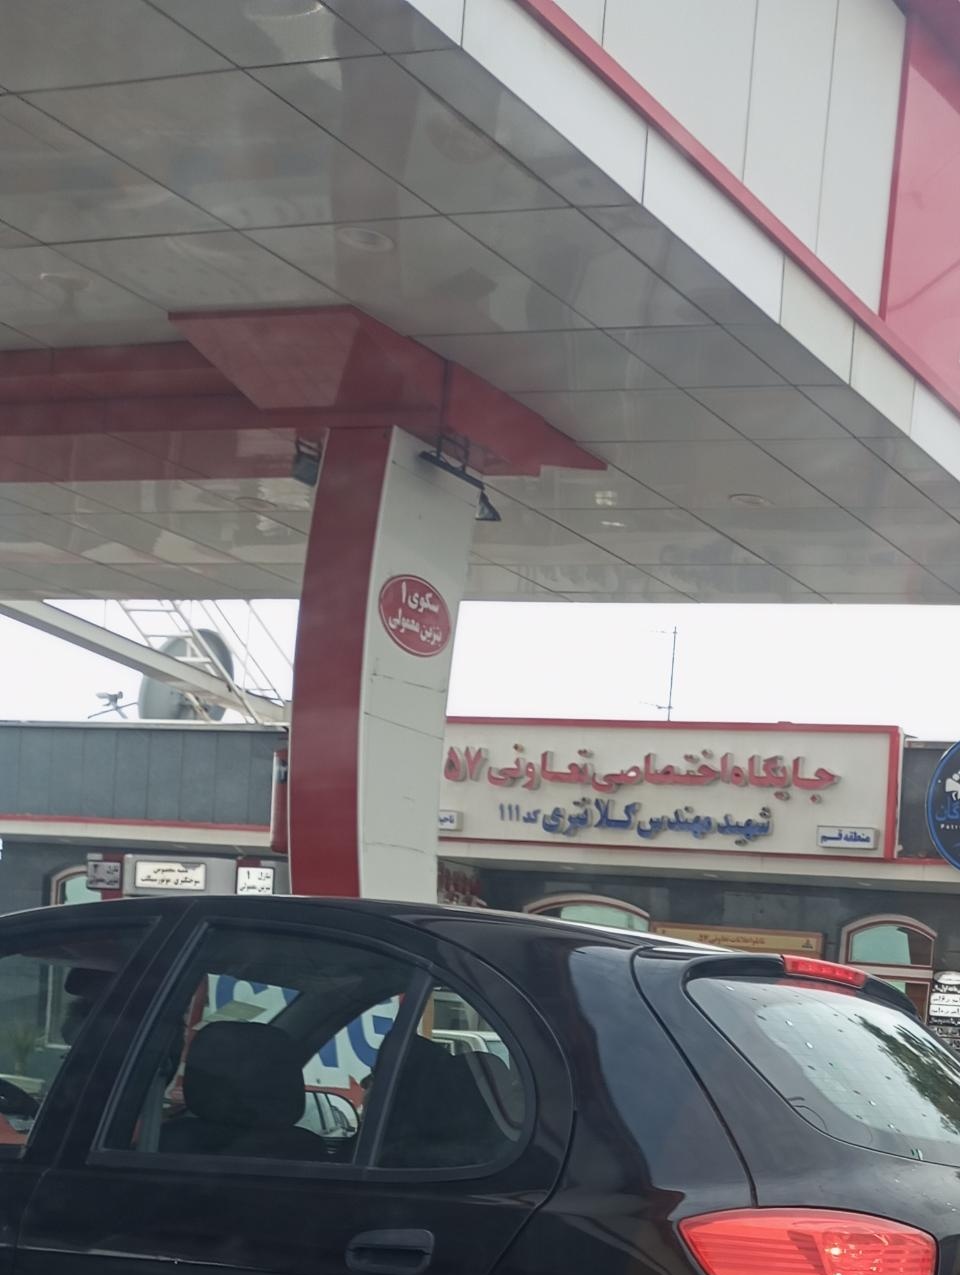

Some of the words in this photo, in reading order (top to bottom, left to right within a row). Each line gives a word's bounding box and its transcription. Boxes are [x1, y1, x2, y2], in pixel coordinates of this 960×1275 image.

[401, 581, 407, 604] ۱
[407, 592, 440, 613] سکوی
[388, 607, 420, 633] معمولی
[420, 625, 442, 646] بنزین
[443, 746, 487, 783] ۵۷
[487, 743, 594, 791] تعاونی
[592, 749, 734, 794] اختصاصی
[731, 754, 842, 804] جایگاه
[439, 815, 455, 826] ناحی
[500, 803, 520, 822] ۱۱۱
[521, 808, 541, 824] کد
[542, 797, 641, 837] کلانتری
[637, 806, 716, 840] مهندس
[717, 806, 773, 846] شهید
[820, 829, 842, 844] قم
[843, 830, 871, 843] منطقه
